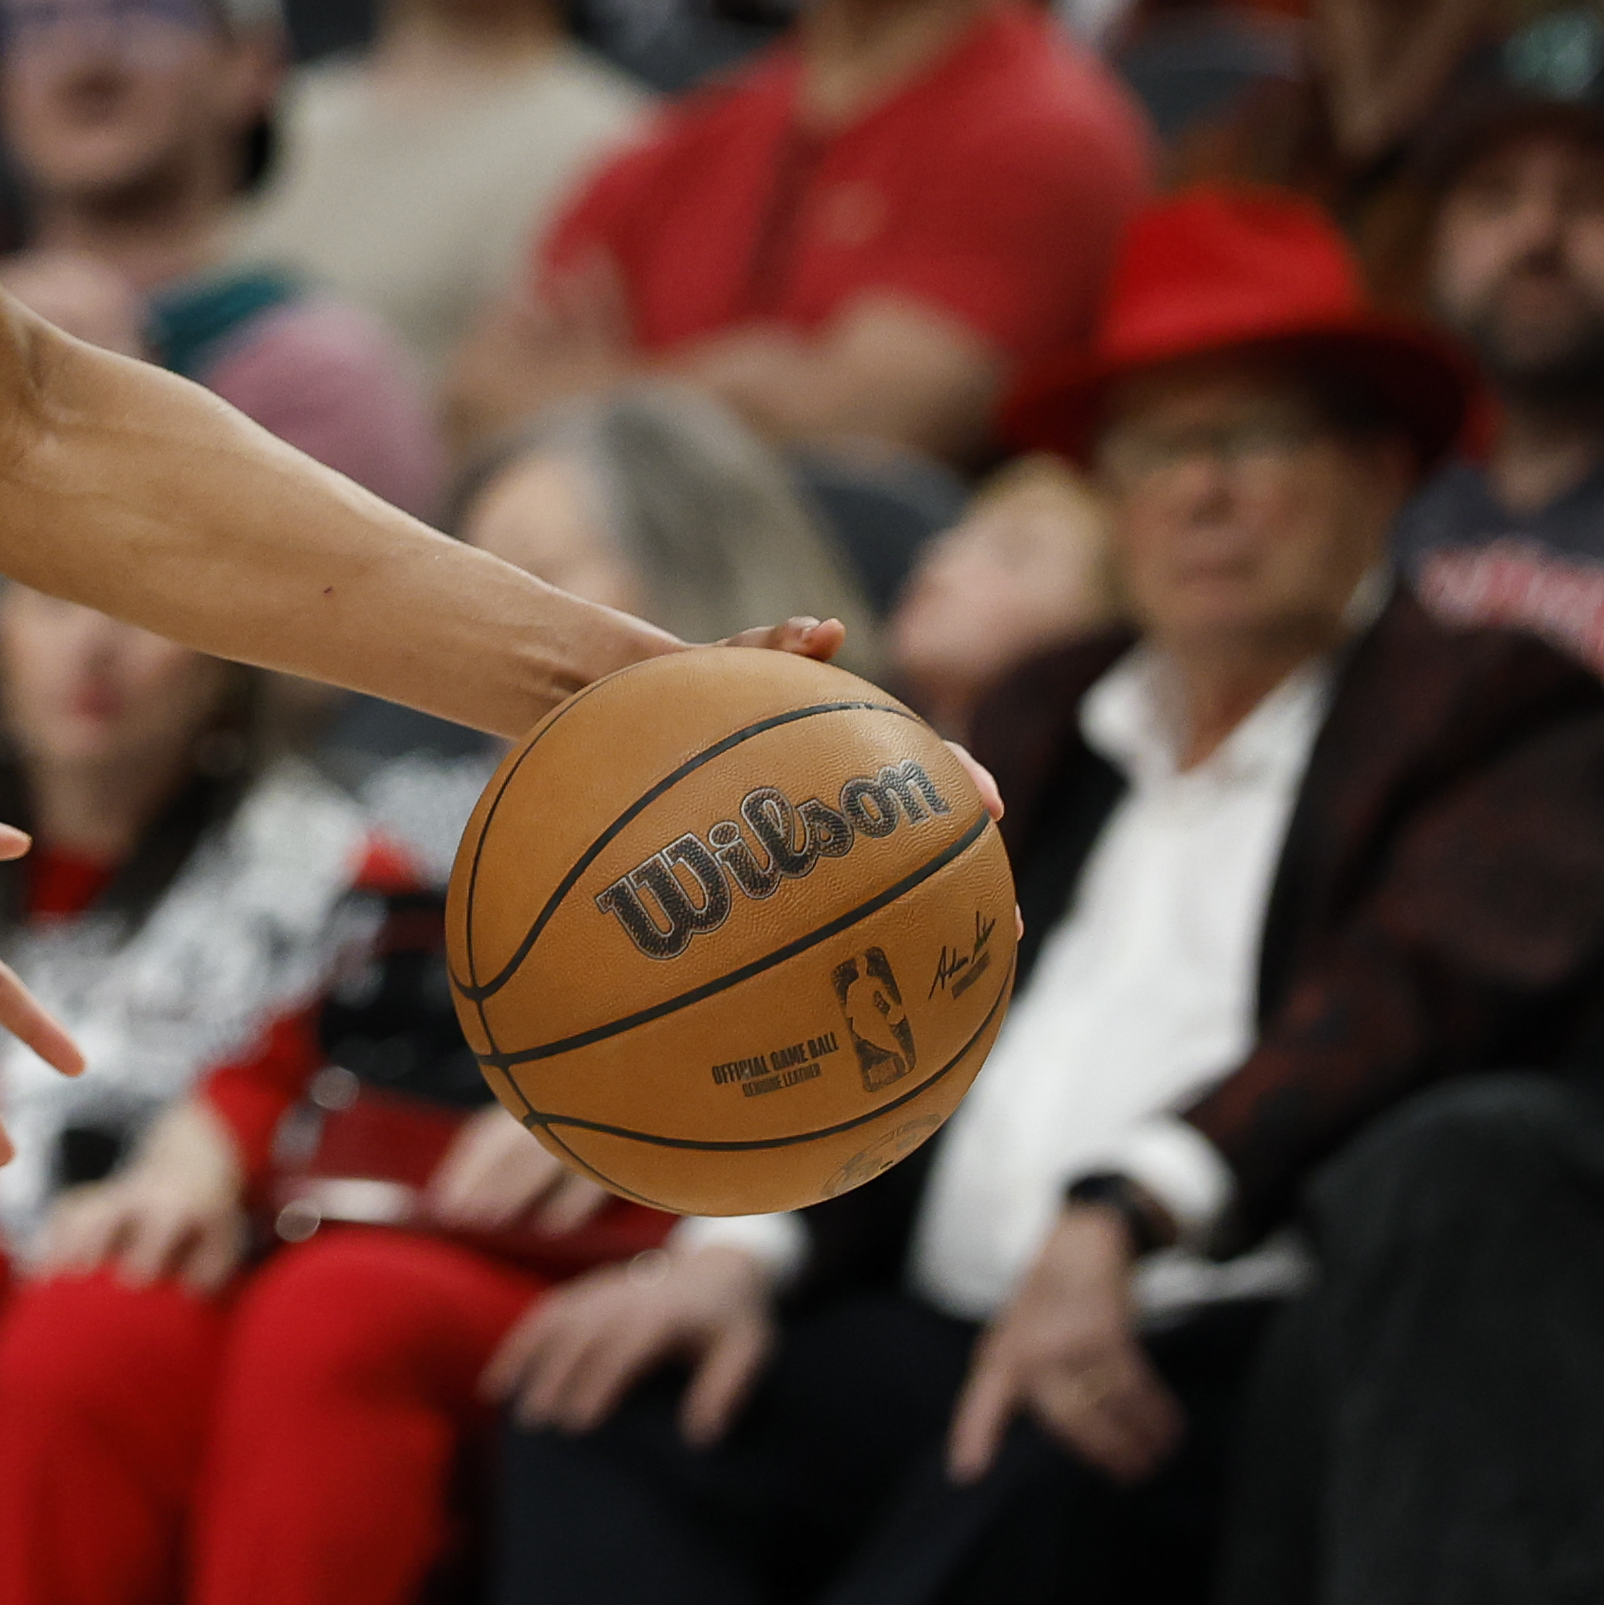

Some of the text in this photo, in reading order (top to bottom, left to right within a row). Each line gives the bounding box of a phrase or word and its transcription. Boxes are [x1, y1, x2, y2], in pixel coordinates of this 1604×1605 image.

[594, 758, 951, 961] Wilson
[711, 1031, 840, 1086] OFFICIAL GAME BALL
